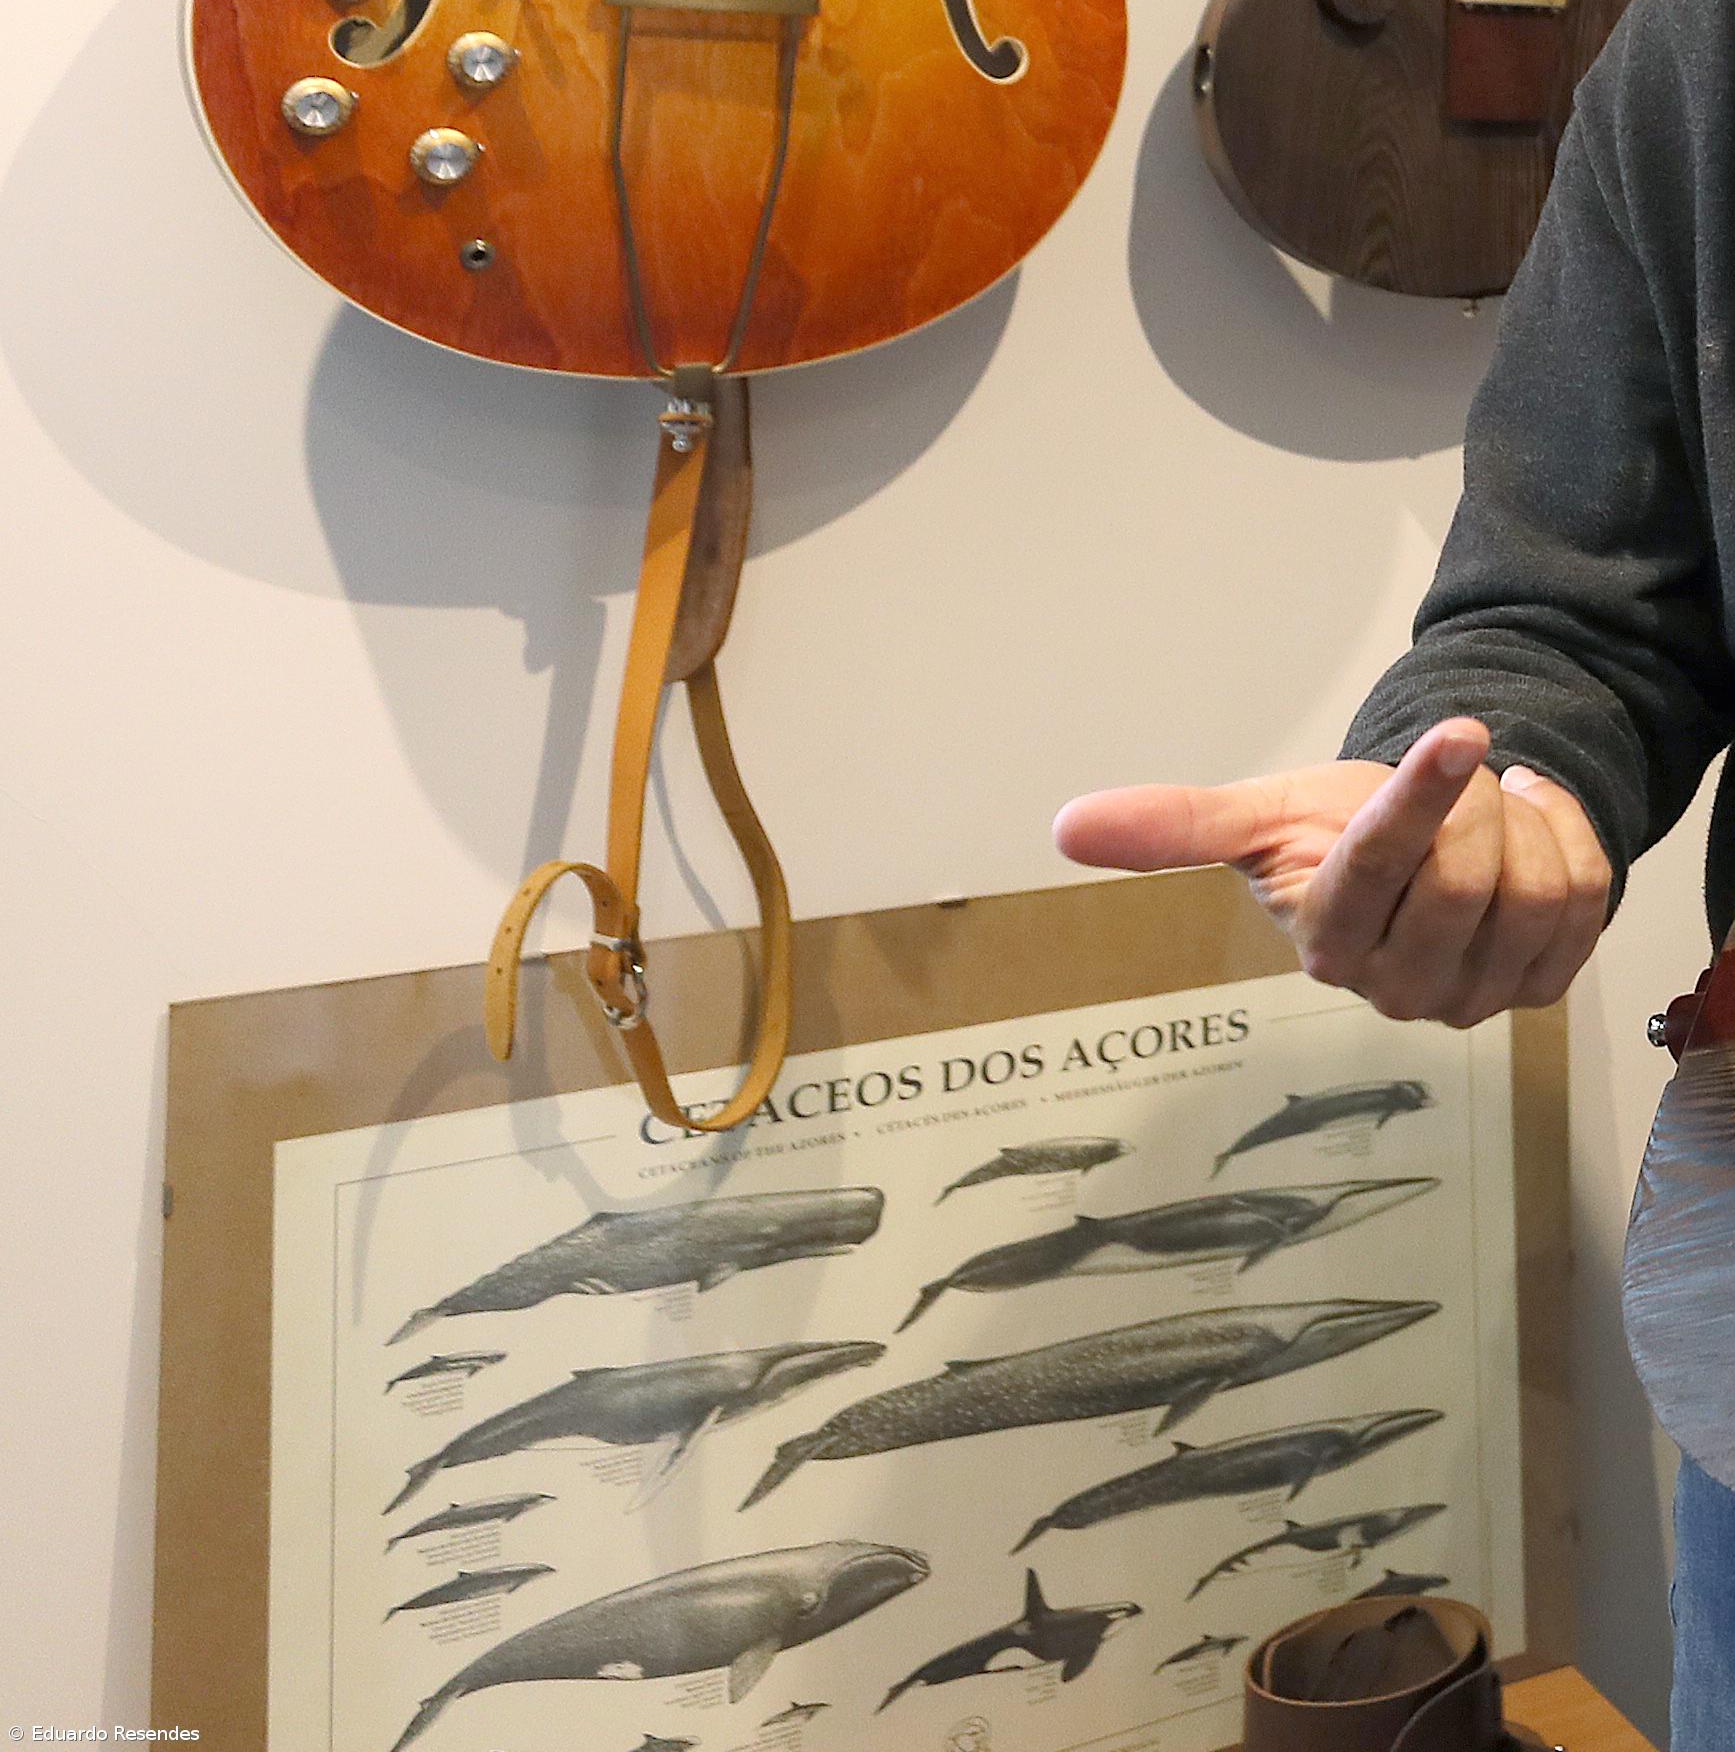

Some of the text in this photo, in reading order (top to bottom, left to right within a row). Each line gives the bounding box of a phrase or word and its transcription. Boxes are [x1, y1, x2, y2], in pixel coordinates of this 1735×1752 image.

[639, 1009, 1249, 1145] CEACEOS DOS AÇORES
